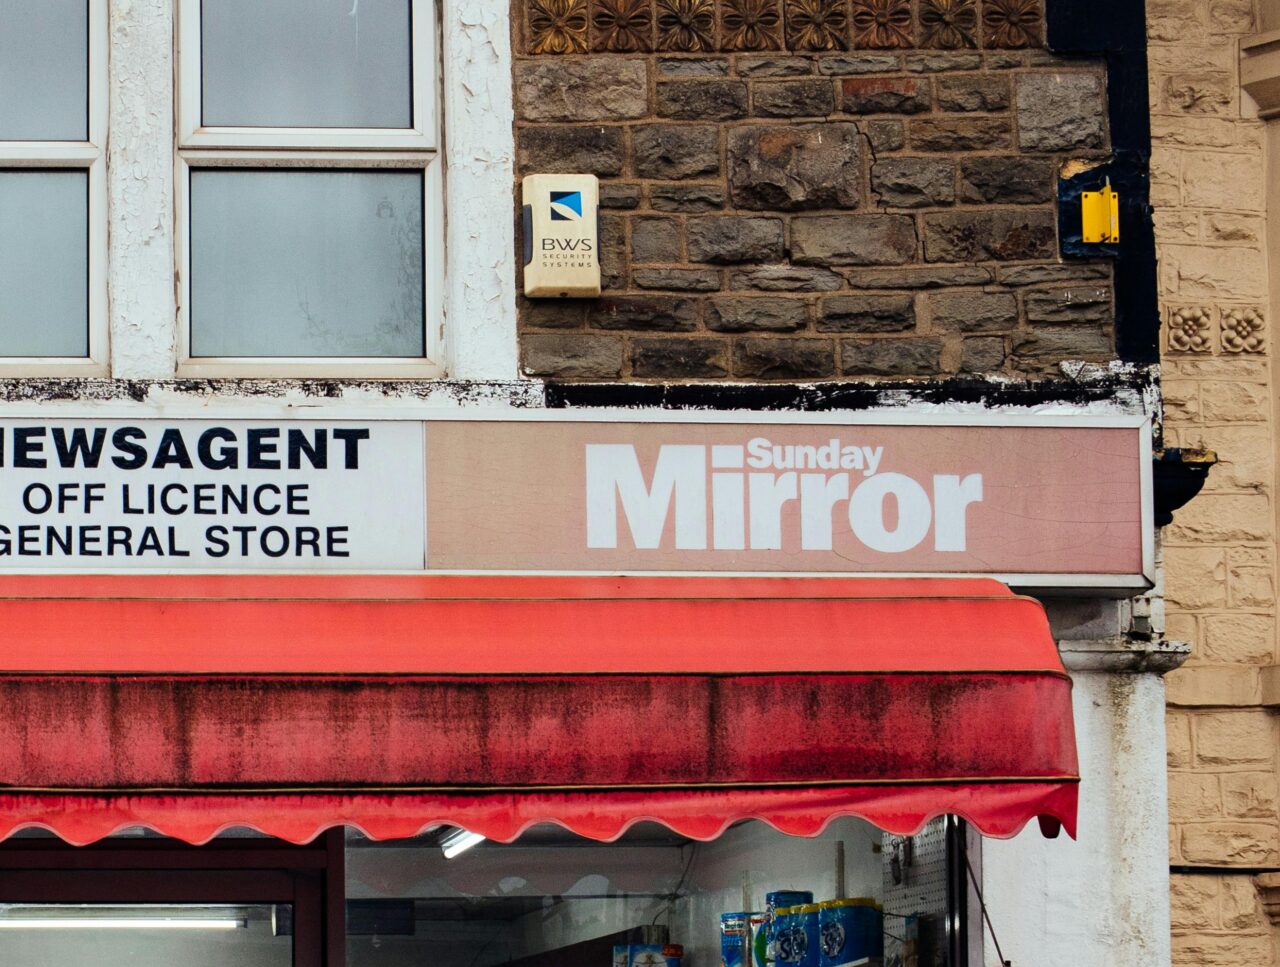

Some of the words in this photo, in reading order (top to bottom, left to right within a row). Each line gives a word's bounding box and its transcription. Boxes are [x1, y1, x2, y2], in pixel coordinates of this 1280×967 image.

[542, 238, 592, 251] BWS
[746, 437, 884, 477] Sunday
[22, 482, 106, 515] OFF
[122, 483, 310, 515] LICENCE
[585, 444, 983, 553] Mirror
[204, 525, 351, 558] STORE
